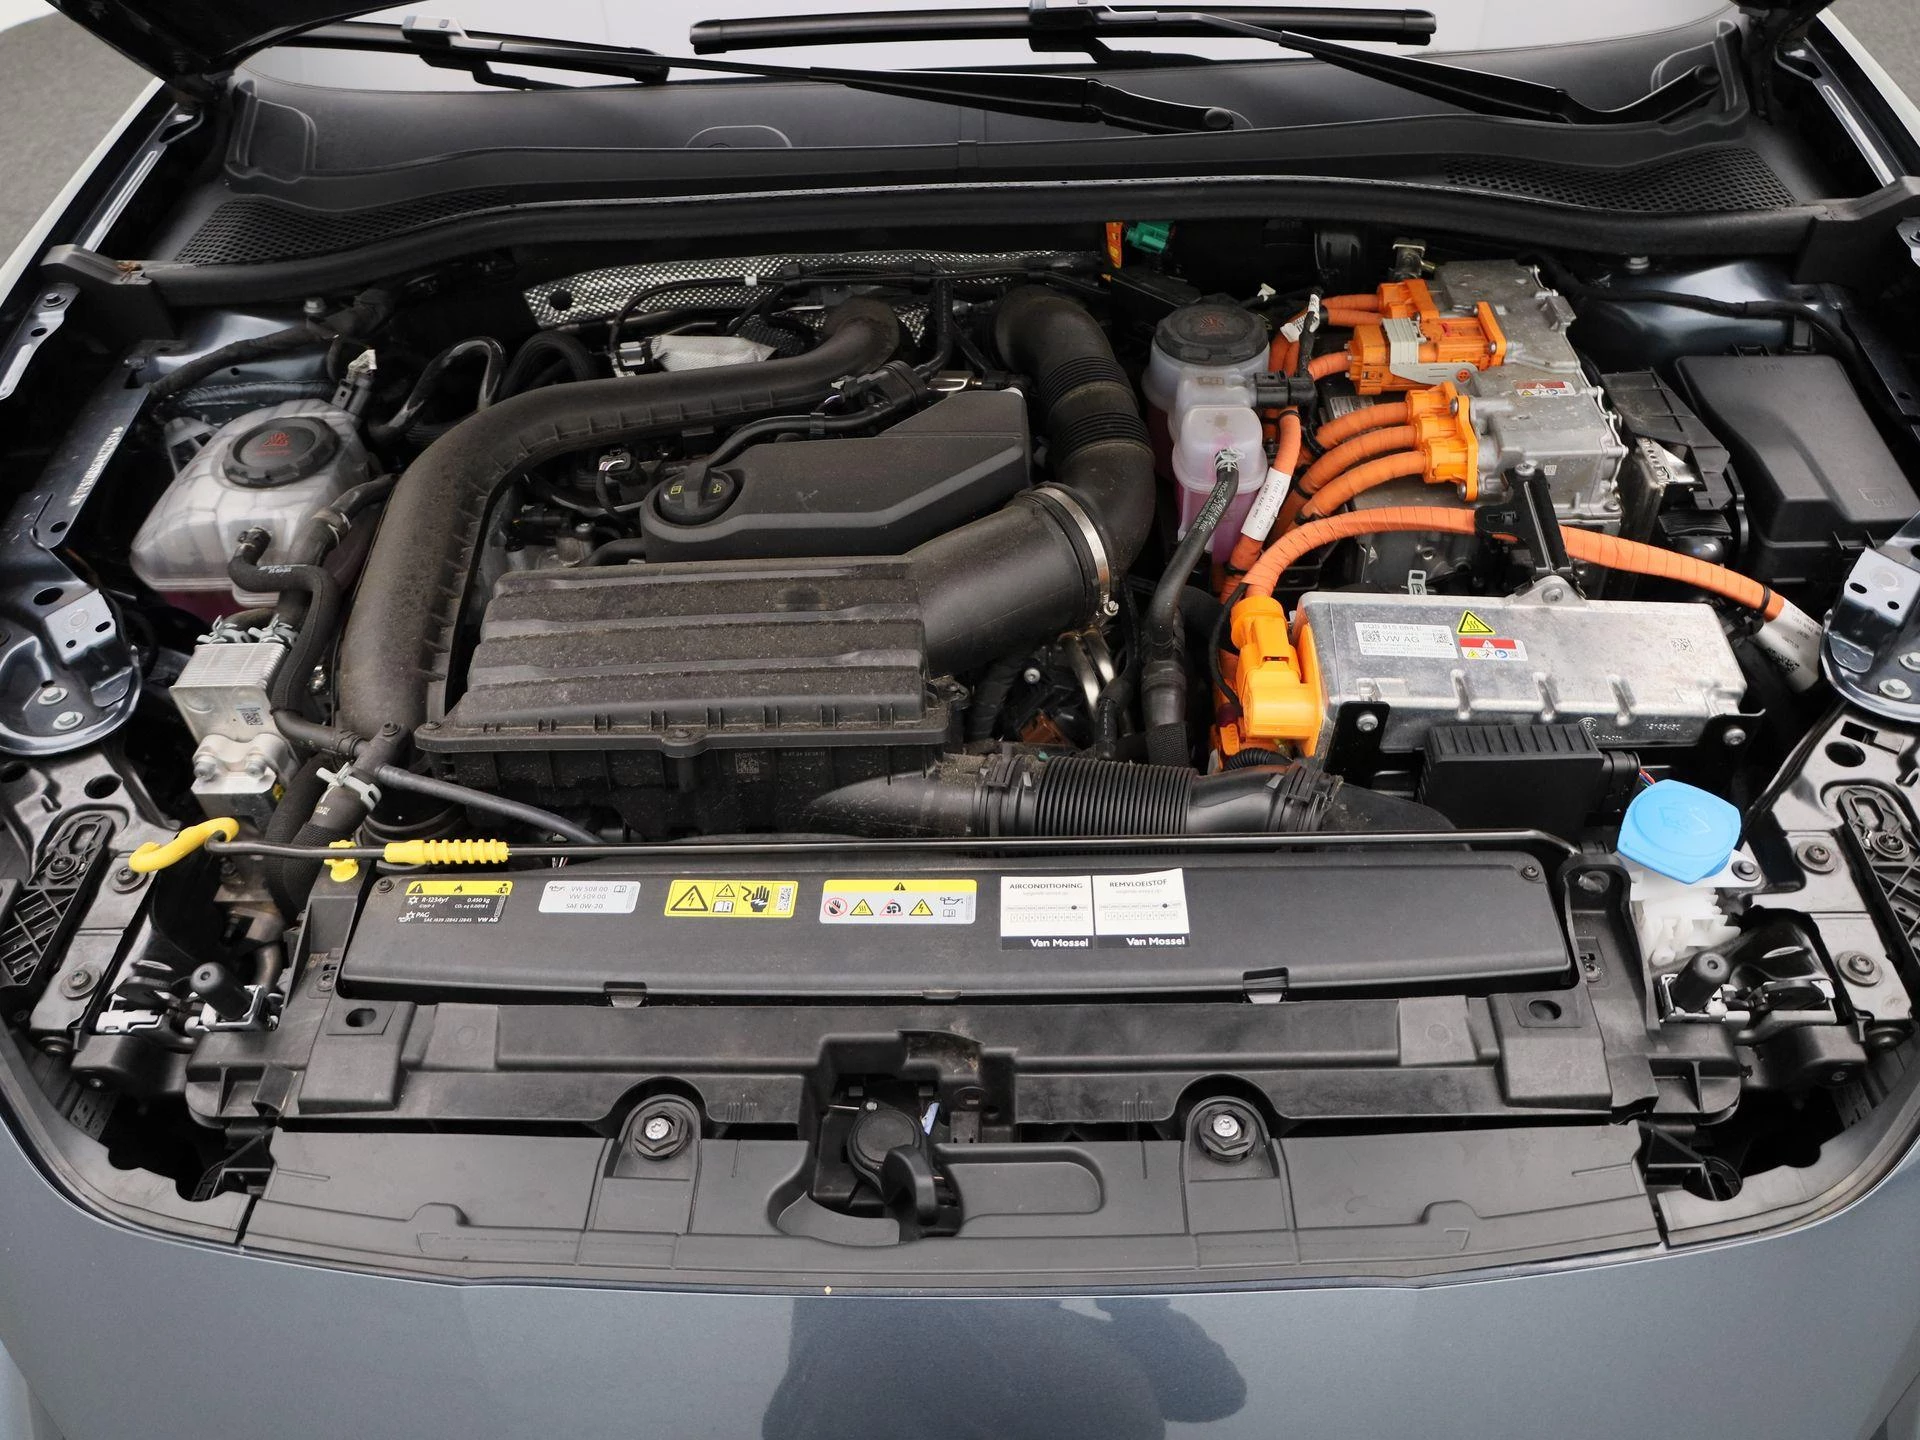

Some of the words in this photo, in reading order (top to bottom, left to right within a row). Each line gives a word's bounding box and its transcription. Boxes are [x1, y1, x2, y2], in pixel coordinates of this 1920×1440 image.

[1109, 879, 1168, 888] REMVLOEISTOF
[421, 896, 449, 904] R-1234yf
[1030, 938, 1050, 947] Van
[1052, 938, 1089, 947] Mossel
[1126, 937, 1147, 946] Van
[1148, 936, 1186, 946] Mossel
